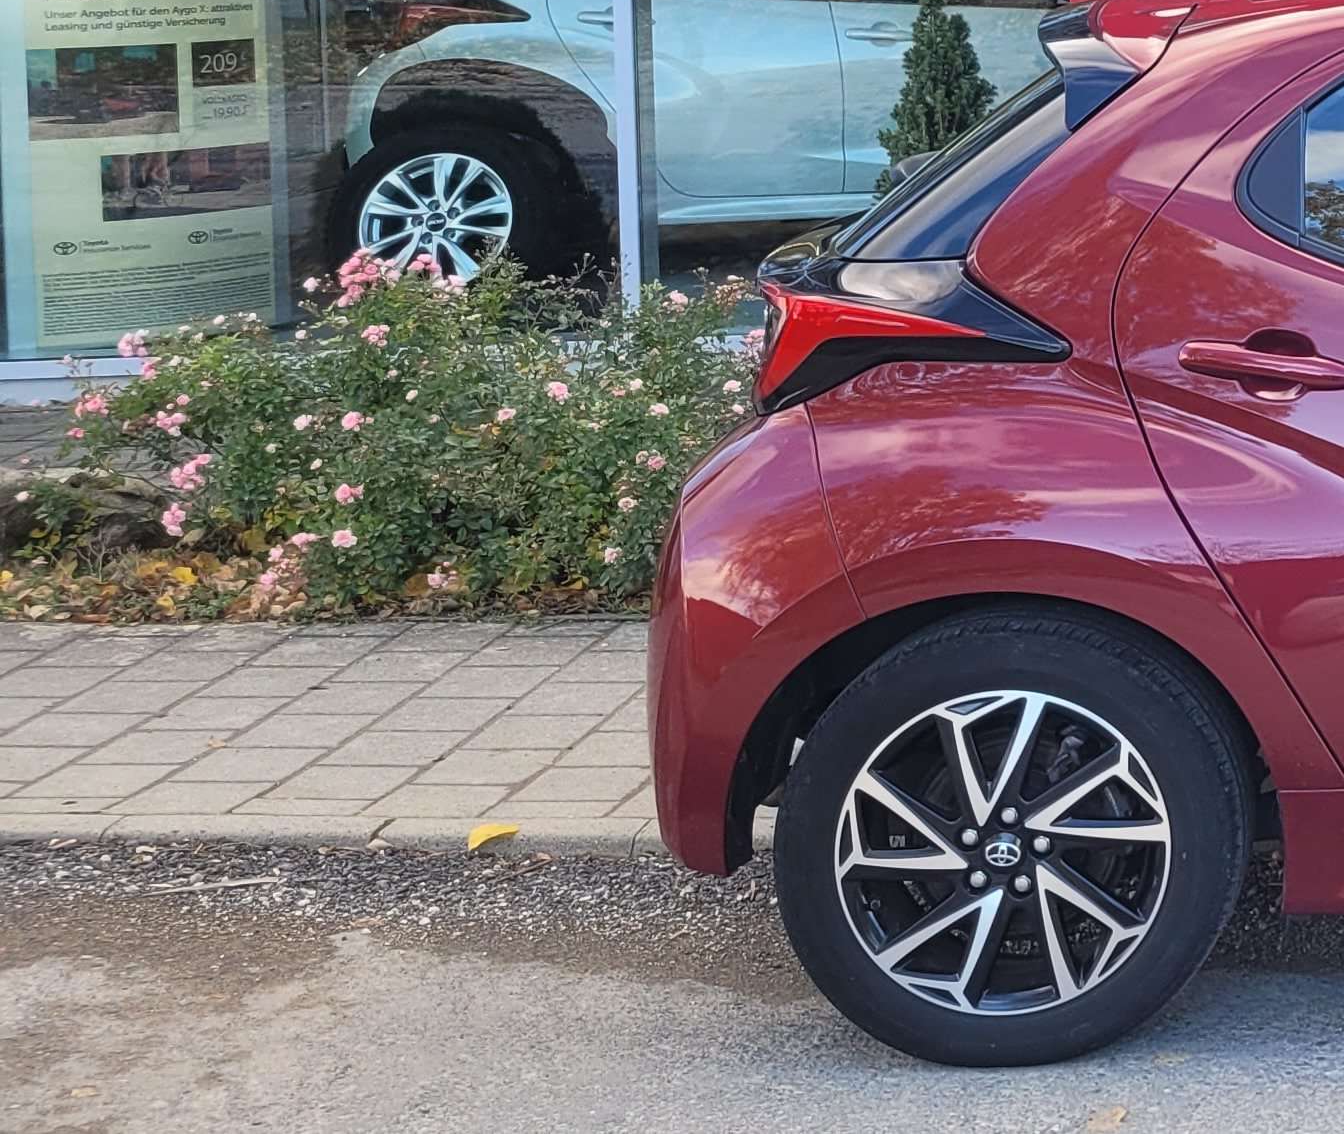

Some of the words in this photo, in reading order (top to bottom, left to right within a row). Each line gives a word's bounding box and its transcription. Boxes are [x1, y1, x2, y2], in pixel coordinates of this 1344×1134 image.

[80, 7, 128, 20] Angebot
[131, 6, 147, 17] für
[149, 5, 170, 16] den
[172, 4, 197, 16] Aygo
[44, 20, 88, 33] Leasing
[91, 18, 113, 30] und
[116, 17, 163, 31] günstige
[165, 14, 226, 28] Versicherung
[199, 52, 238, 74] 209
